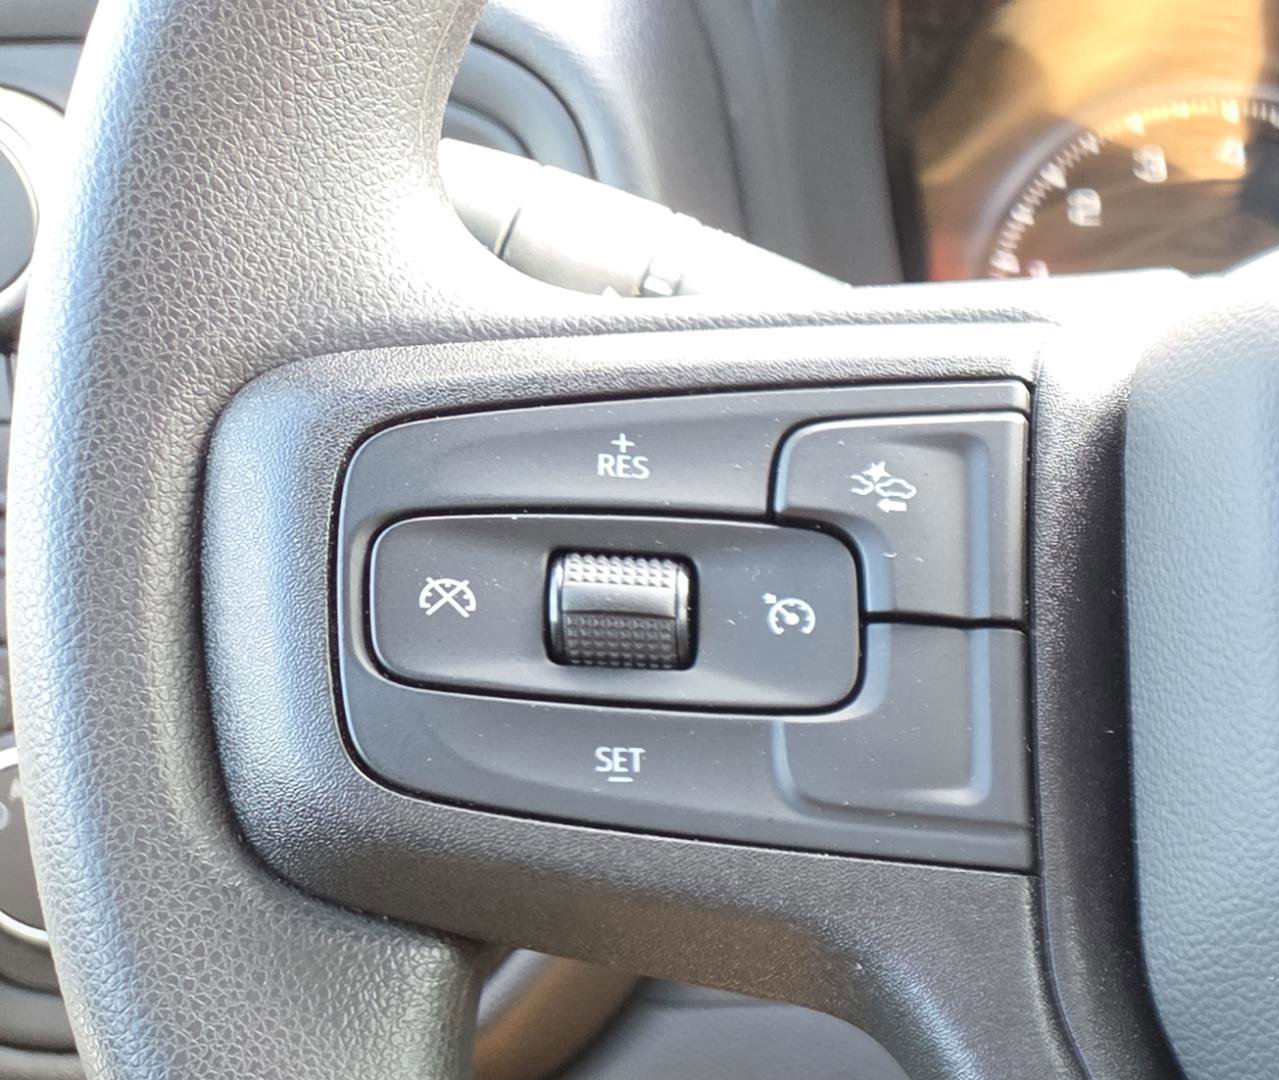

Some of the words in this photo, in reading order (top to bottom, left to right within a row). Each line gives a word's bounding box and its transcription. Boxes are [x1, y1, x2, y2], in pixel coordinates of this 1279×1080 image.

[1132, 143, 1168, 183] 3
[1067, 188, 1102, 227] 2
[597, 453, 650, 479] RES
[594, 747, 646, 773] SET
